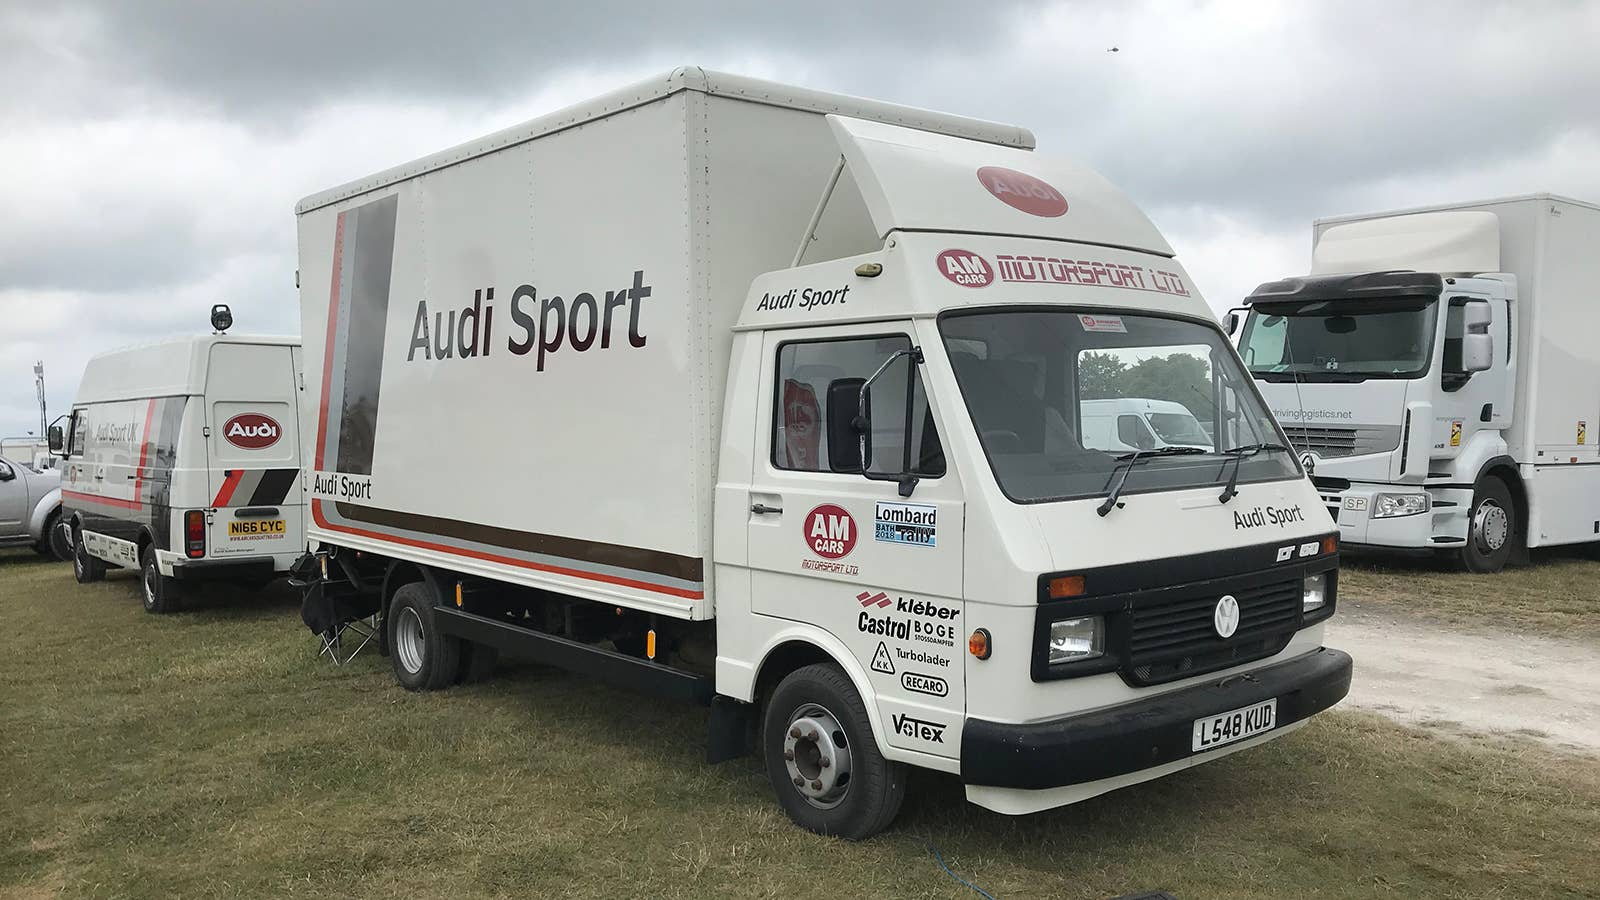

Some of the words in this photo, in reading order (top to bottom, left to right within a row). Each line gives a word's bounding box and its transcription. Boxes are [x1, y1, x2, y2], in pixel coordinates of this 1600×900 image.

[944, 255, 987, 274] AM
[997, 254, 1146, 289] MOTORSPORT
[956, 274, 987, 284] CARS
[757, 288, 797, 311] Audi
[799, 284, 850, 311] Sport
[406, 287, 494, 361] Audi
[508, 270, 652, 372] Sport
[228, 422, 277, 437] Audi
[314, 474, 337, 495] Audi
[341, 476, 371, 502] Sport
[875, 504, 937, 525] Lombard
[1234, 507, 1266, 530] Audi
[1266, 504, 1305, 528] Sport
[231, 522, 258, 533] N166
[260, 521, 283, 532] CYC
[810, 513, 850, 542] AM
[875, 531, 895, 540] 2018
[876, 523, 895, 532] BATH
[900, 528, 931, 543] rally
[814, 538, 845, 554] CARS
[802, 559, 845, 574] MOTORSPORT
[858, 611, 911, 640] Castrol
[914, 620, 955, 639] BOGE
[879, 650, 885, 658] K
[896, 647, 950, 667] Turbolader
[906, 676, 943, 692] RECARO
[1200, 713, 1242, 746] L548
[1245, 704, 1272, 734] KUD
